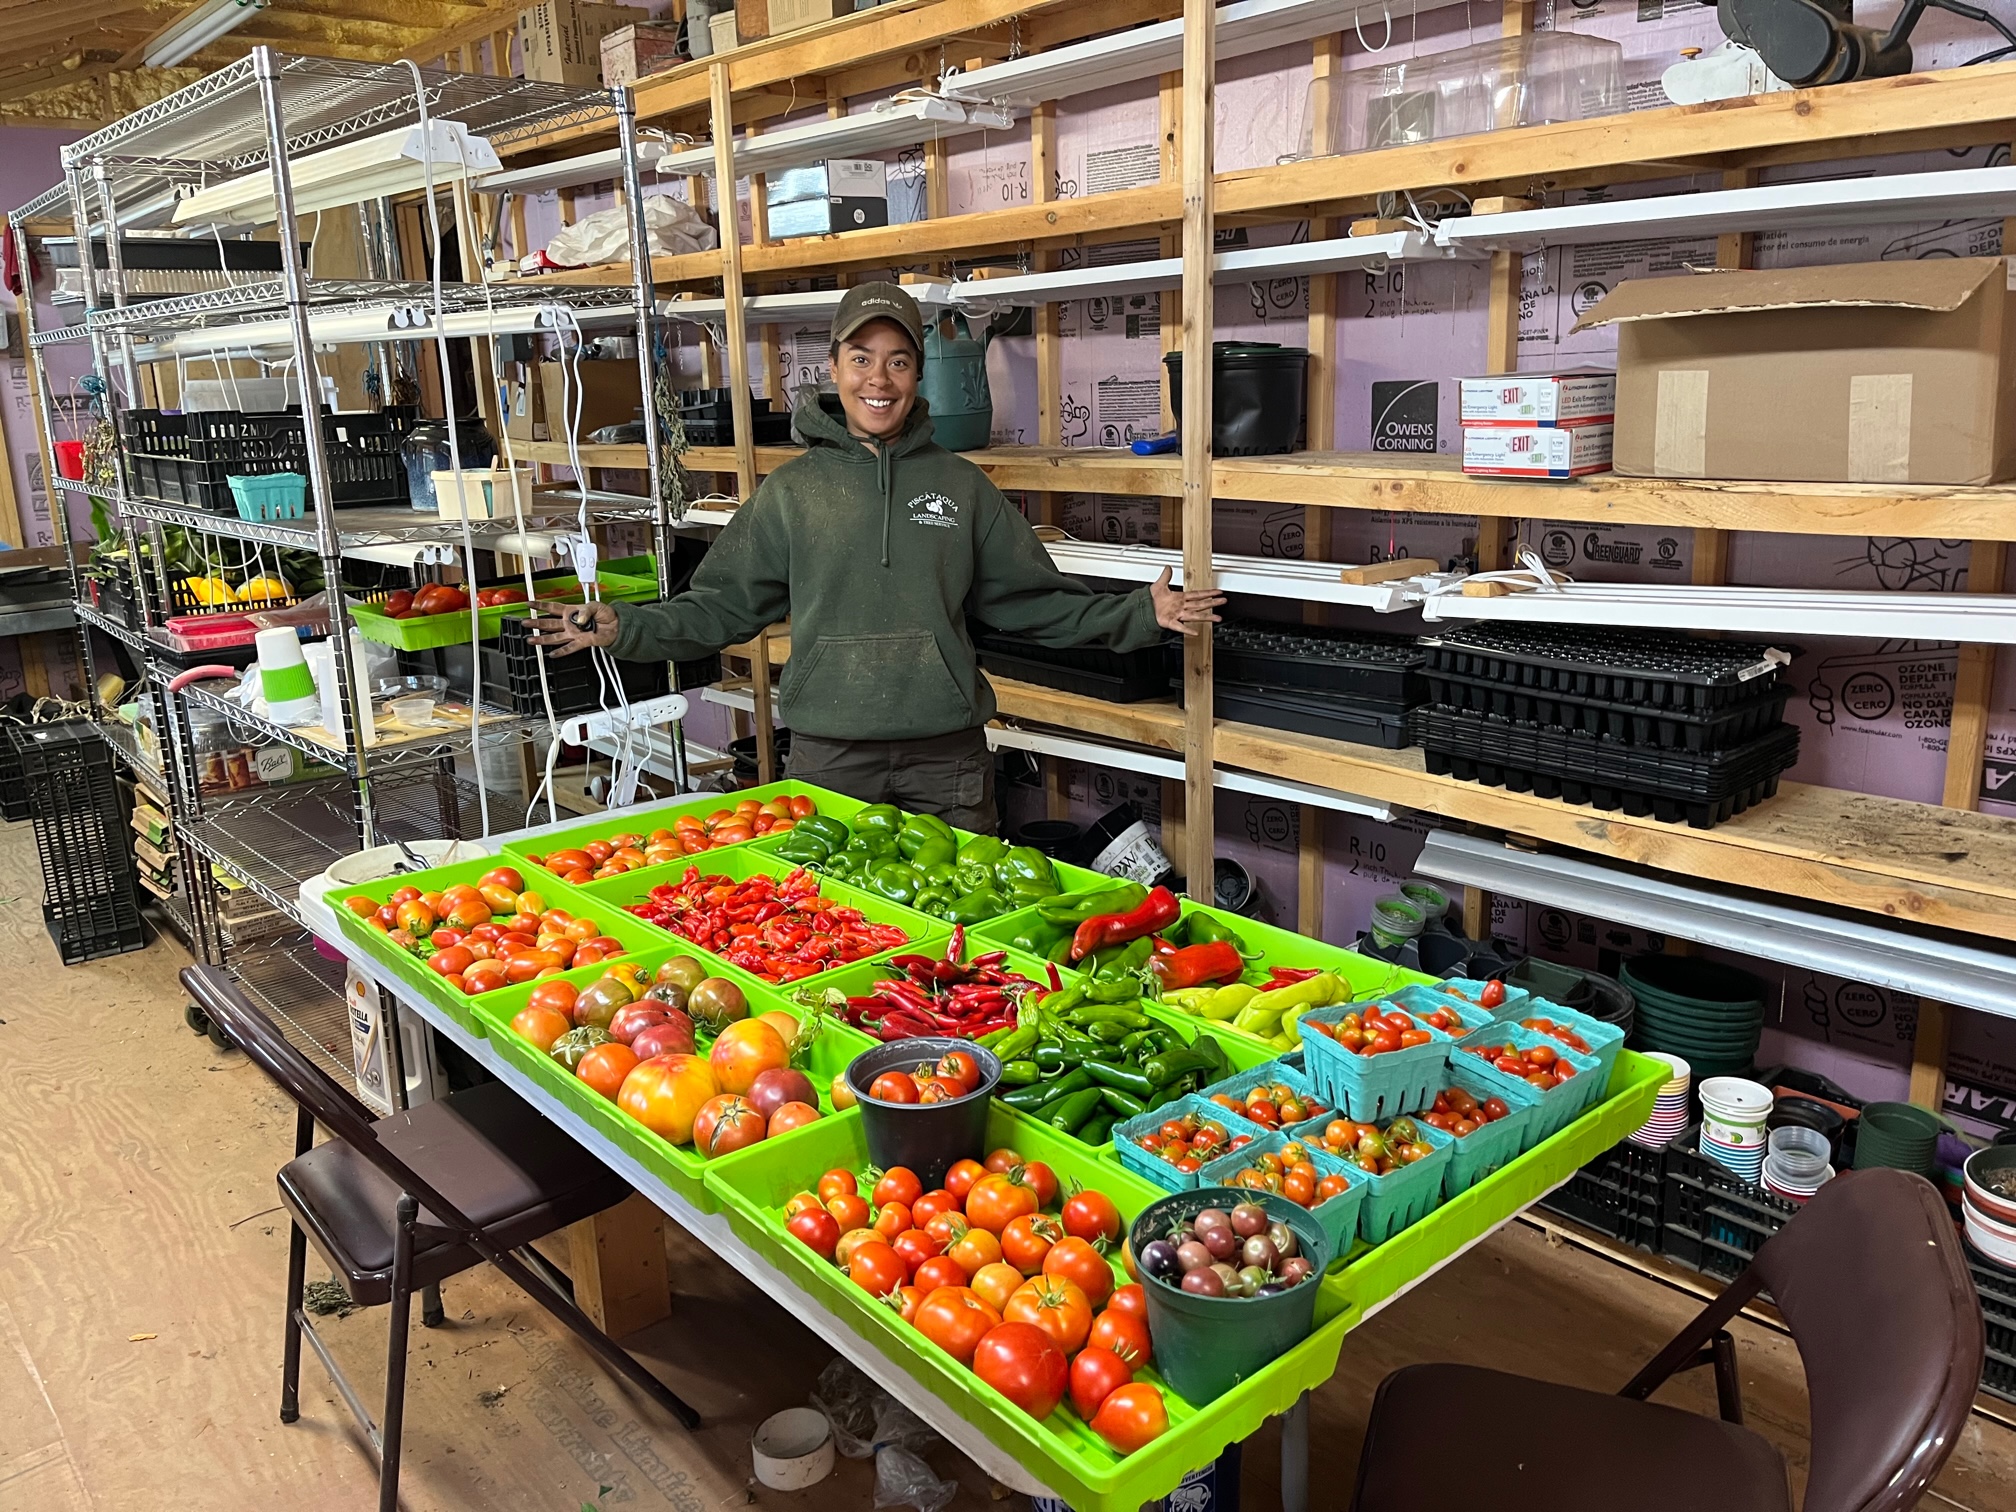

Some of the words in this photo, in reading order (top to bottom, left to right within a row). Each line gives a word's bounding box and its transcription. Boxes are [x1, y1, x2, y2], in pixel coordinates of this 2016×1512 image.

[1002, 181, 1028, 201] R-10
[1790, 240, 1826, 249] consumo
[1828, 237, 1838, 245] de
[1365, 271, 1404, 295] R-10
[1541, 285, 1555, 296] LA
[1275, 290, 1294, 302] CERO
[861, 297, 891, 307] adidas
[1523, 300, 1536, 310] DE
[1364, 299, 1375, 318] 2
[1503, 387, 1519, 404] EXIT
[1561, 396, 1571, 404] LED
[1520, 405, 1533, 415] EXIT
[1386, 422, 1434, 436] OWENS
[1376, 436, 1434, 450] CORNING
[1512, 435, 1530, 452] EXIT
[1531, 453, 1542, 463] EXIT
[907, 491, 959, 512] PISCATAQUA
[912, 513, 956, 523] LANDSCAPING
[1401, 517, 1412, 525] XPS
[1283, 531, 1301, 540] ZERO
[1285, 543, 1304, 552] CERO
[1898, 663, 1946, 674] OZONE
[1851, 683, 1884, 694] ZERO
[1933, 691, 1947, 699] QUE
[1853, 700, 1886, 710] CERO
[1902, 700, 1923, 710] NO
[1903, 709, 1939, 719] CAPA
[1840, 725, 1903, 740] www.foamular.com
[261, 753, 287, 773] Ball
[1266, 816, 1284, 824] ZERO
[1350, 836, 1386, 862] R-10
[1349, 860, 1359, 876] 2
[1363, 863, 1378, 873] inch
[1511, 901, 1523, 909] LA
[1495, 909, 1506, 917] DE
[1843, 991, 1876, 1001] ZERO
[1846, 1007, 1878, 1018] CERO
[1893, 1013, 1914, 1022] NO
